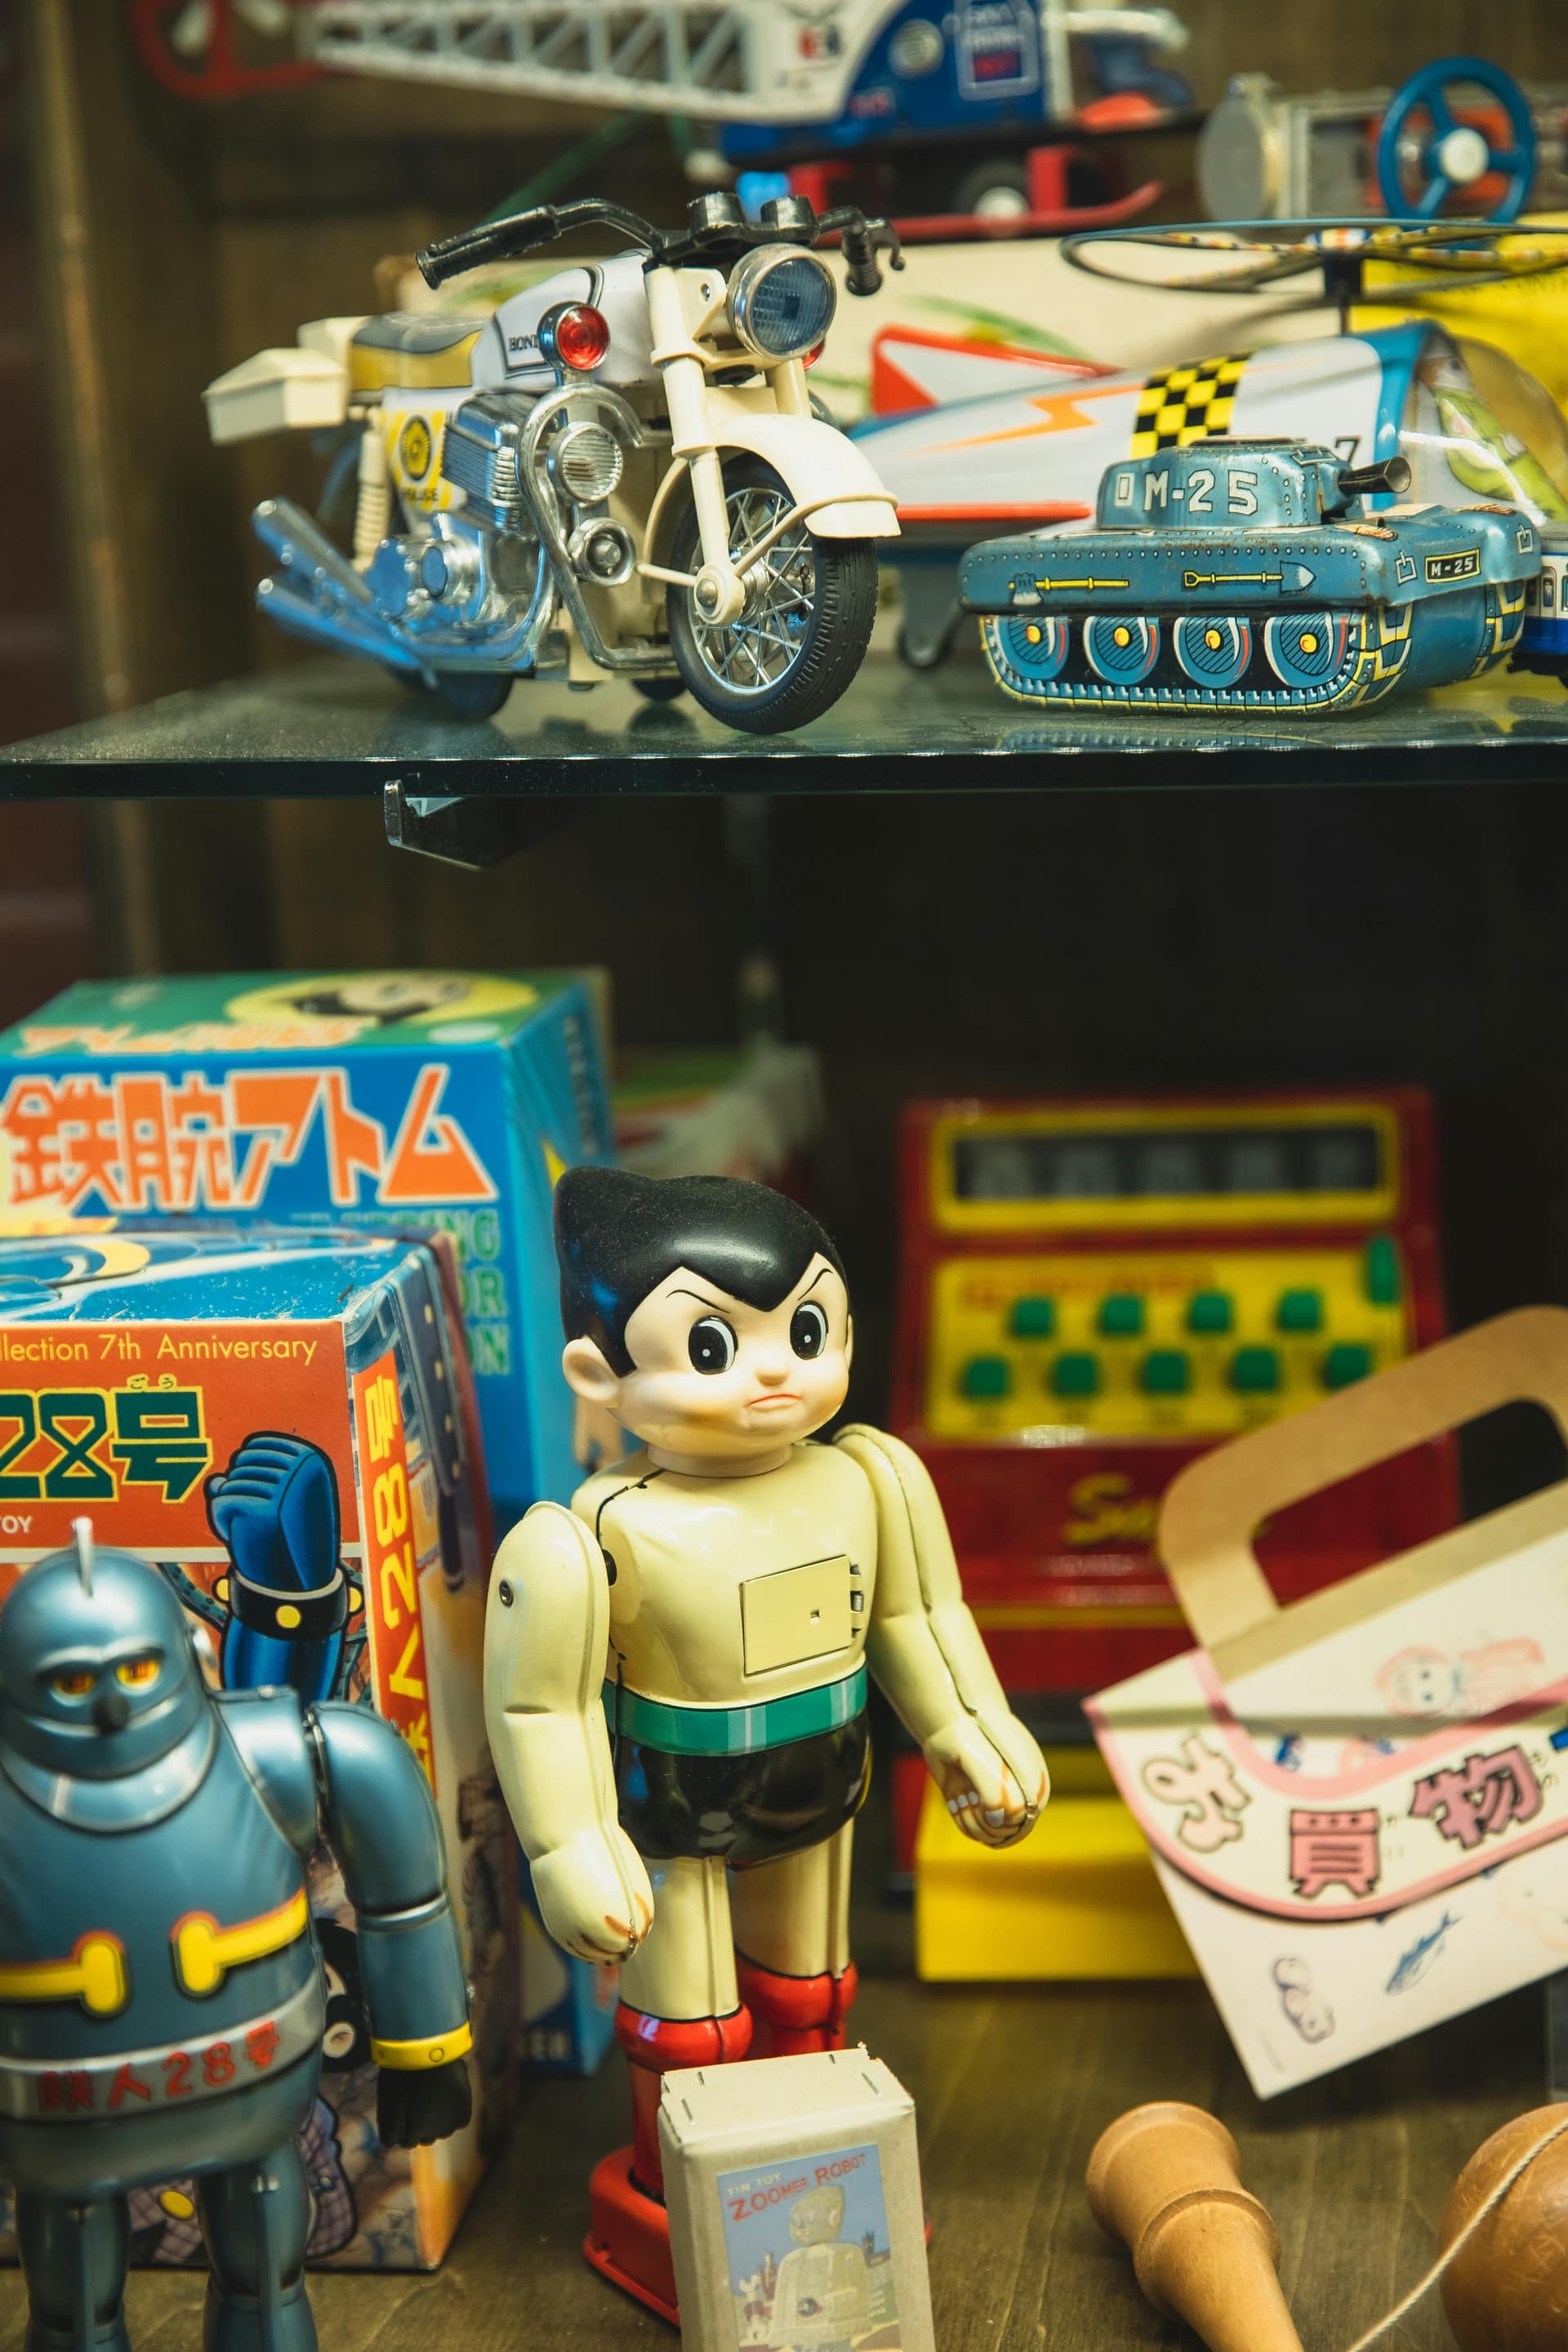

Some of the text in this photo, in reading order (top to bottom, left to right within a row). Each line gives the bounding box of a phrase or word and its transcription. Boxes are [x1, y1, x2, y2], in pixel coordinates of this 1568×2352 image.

[1143, 468, 1258, 515] M-25
[1431, 556, 1474, 577] M-25
[0, 1063, 500, 1211] 鉄腕アトム
[98, 1332, 141, 1360] 7th
[156, 1333, 318, 1365] Anniversary
[0, 1515, 32, 1534] OY
[728, 2172, 782, 2197] TIN TOY
[728, 2153, 866, 2221] ZOOMER ROBOT
